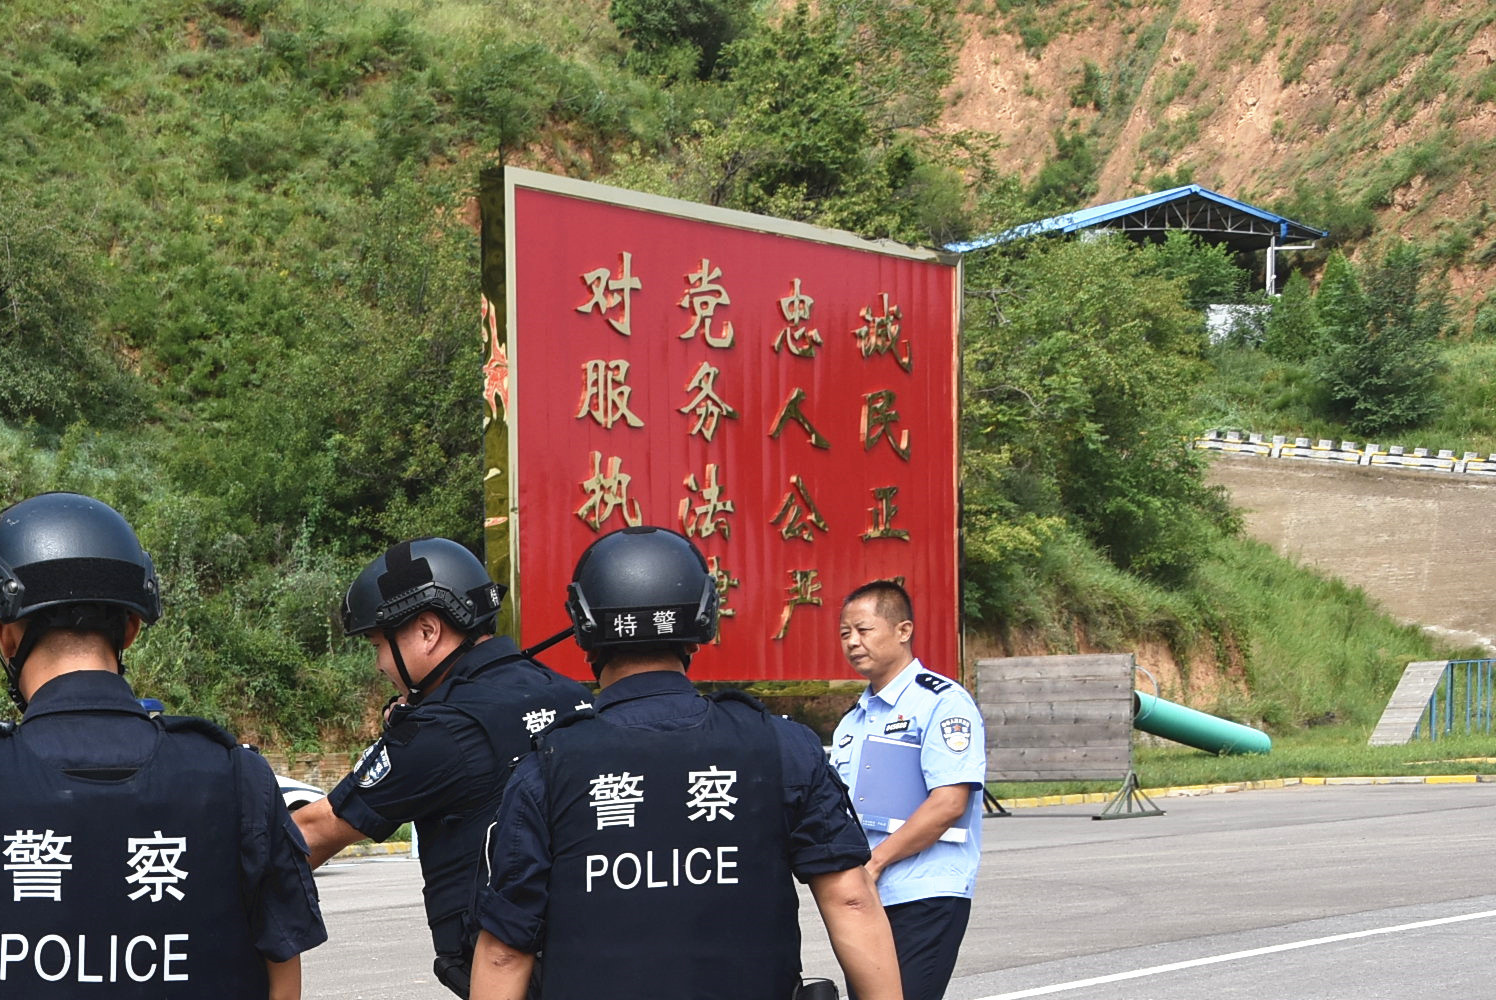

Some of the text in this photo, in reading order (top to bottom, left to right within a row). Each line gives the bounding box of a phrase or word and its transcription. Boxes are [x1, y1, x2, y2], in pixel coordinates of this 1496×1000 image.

[575, 251, 913, 373] 对党忠诚
[575, 359, 912, 462] 服务人民
[574, 451, 911, 542] 执法公正
[613, 609, 676, 638] 特警
[589, 765, 739, 830] 警察
[2, 829, 189, 903] 警察
[586, 846, 739, 893] POLICE
[0, 933, 189, 983] POLICE
